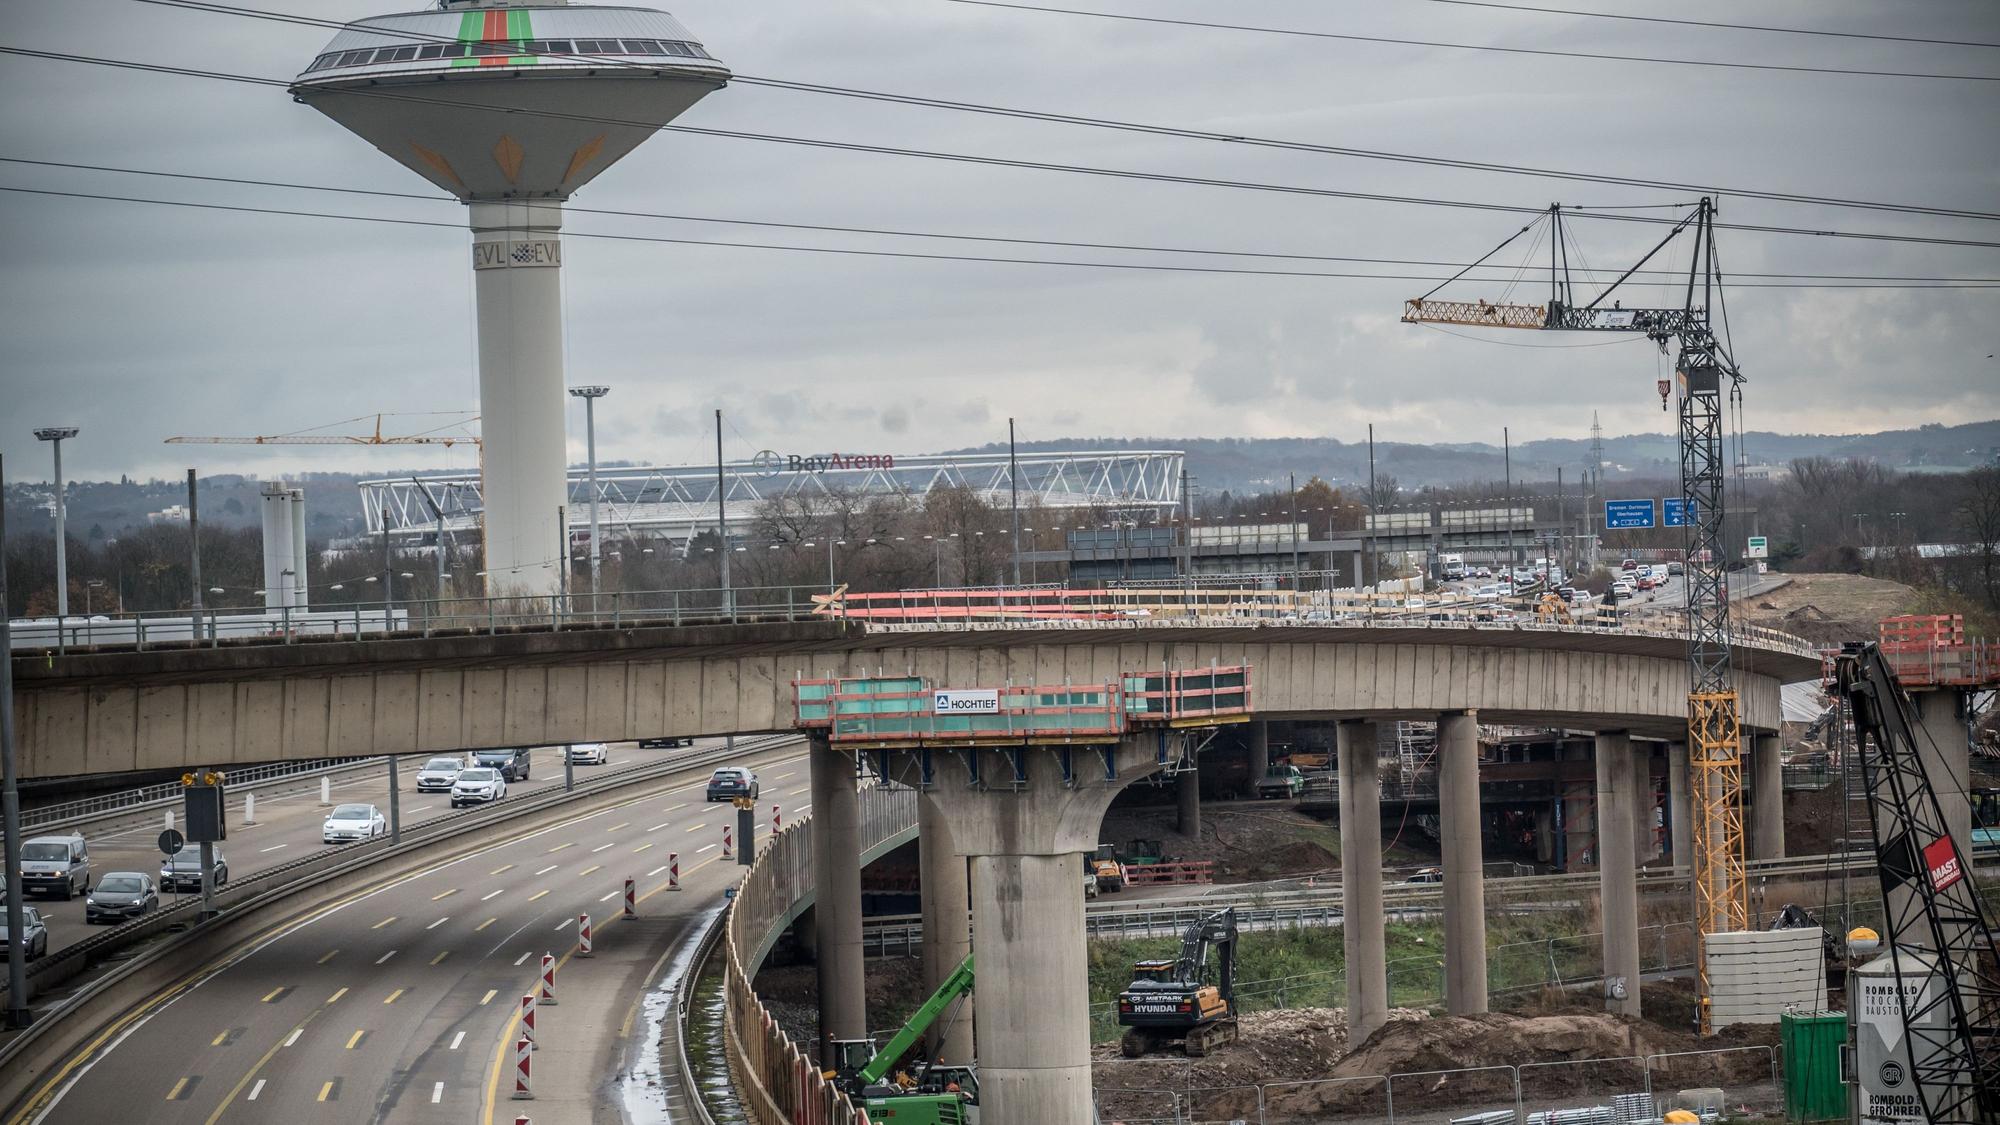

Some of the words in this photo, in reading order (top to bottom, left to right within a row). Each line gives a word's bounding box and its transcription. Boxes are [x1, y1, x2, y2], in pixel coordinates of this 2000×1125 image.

[787, 453, 894, 473] BayArena
[951, 699, 997, 709] HOCHTIEF
[1931, 857, 1957, 882] MAST
[1134, 1004, 1176, 1013] HYUNDAI
[1866, 1006, 1918, 1016] BAUSTOFE
[1869, 1094, 1914, 1105] ROMBOLD
[1869, 1104, 1921, 1116] GFRÖHRER
